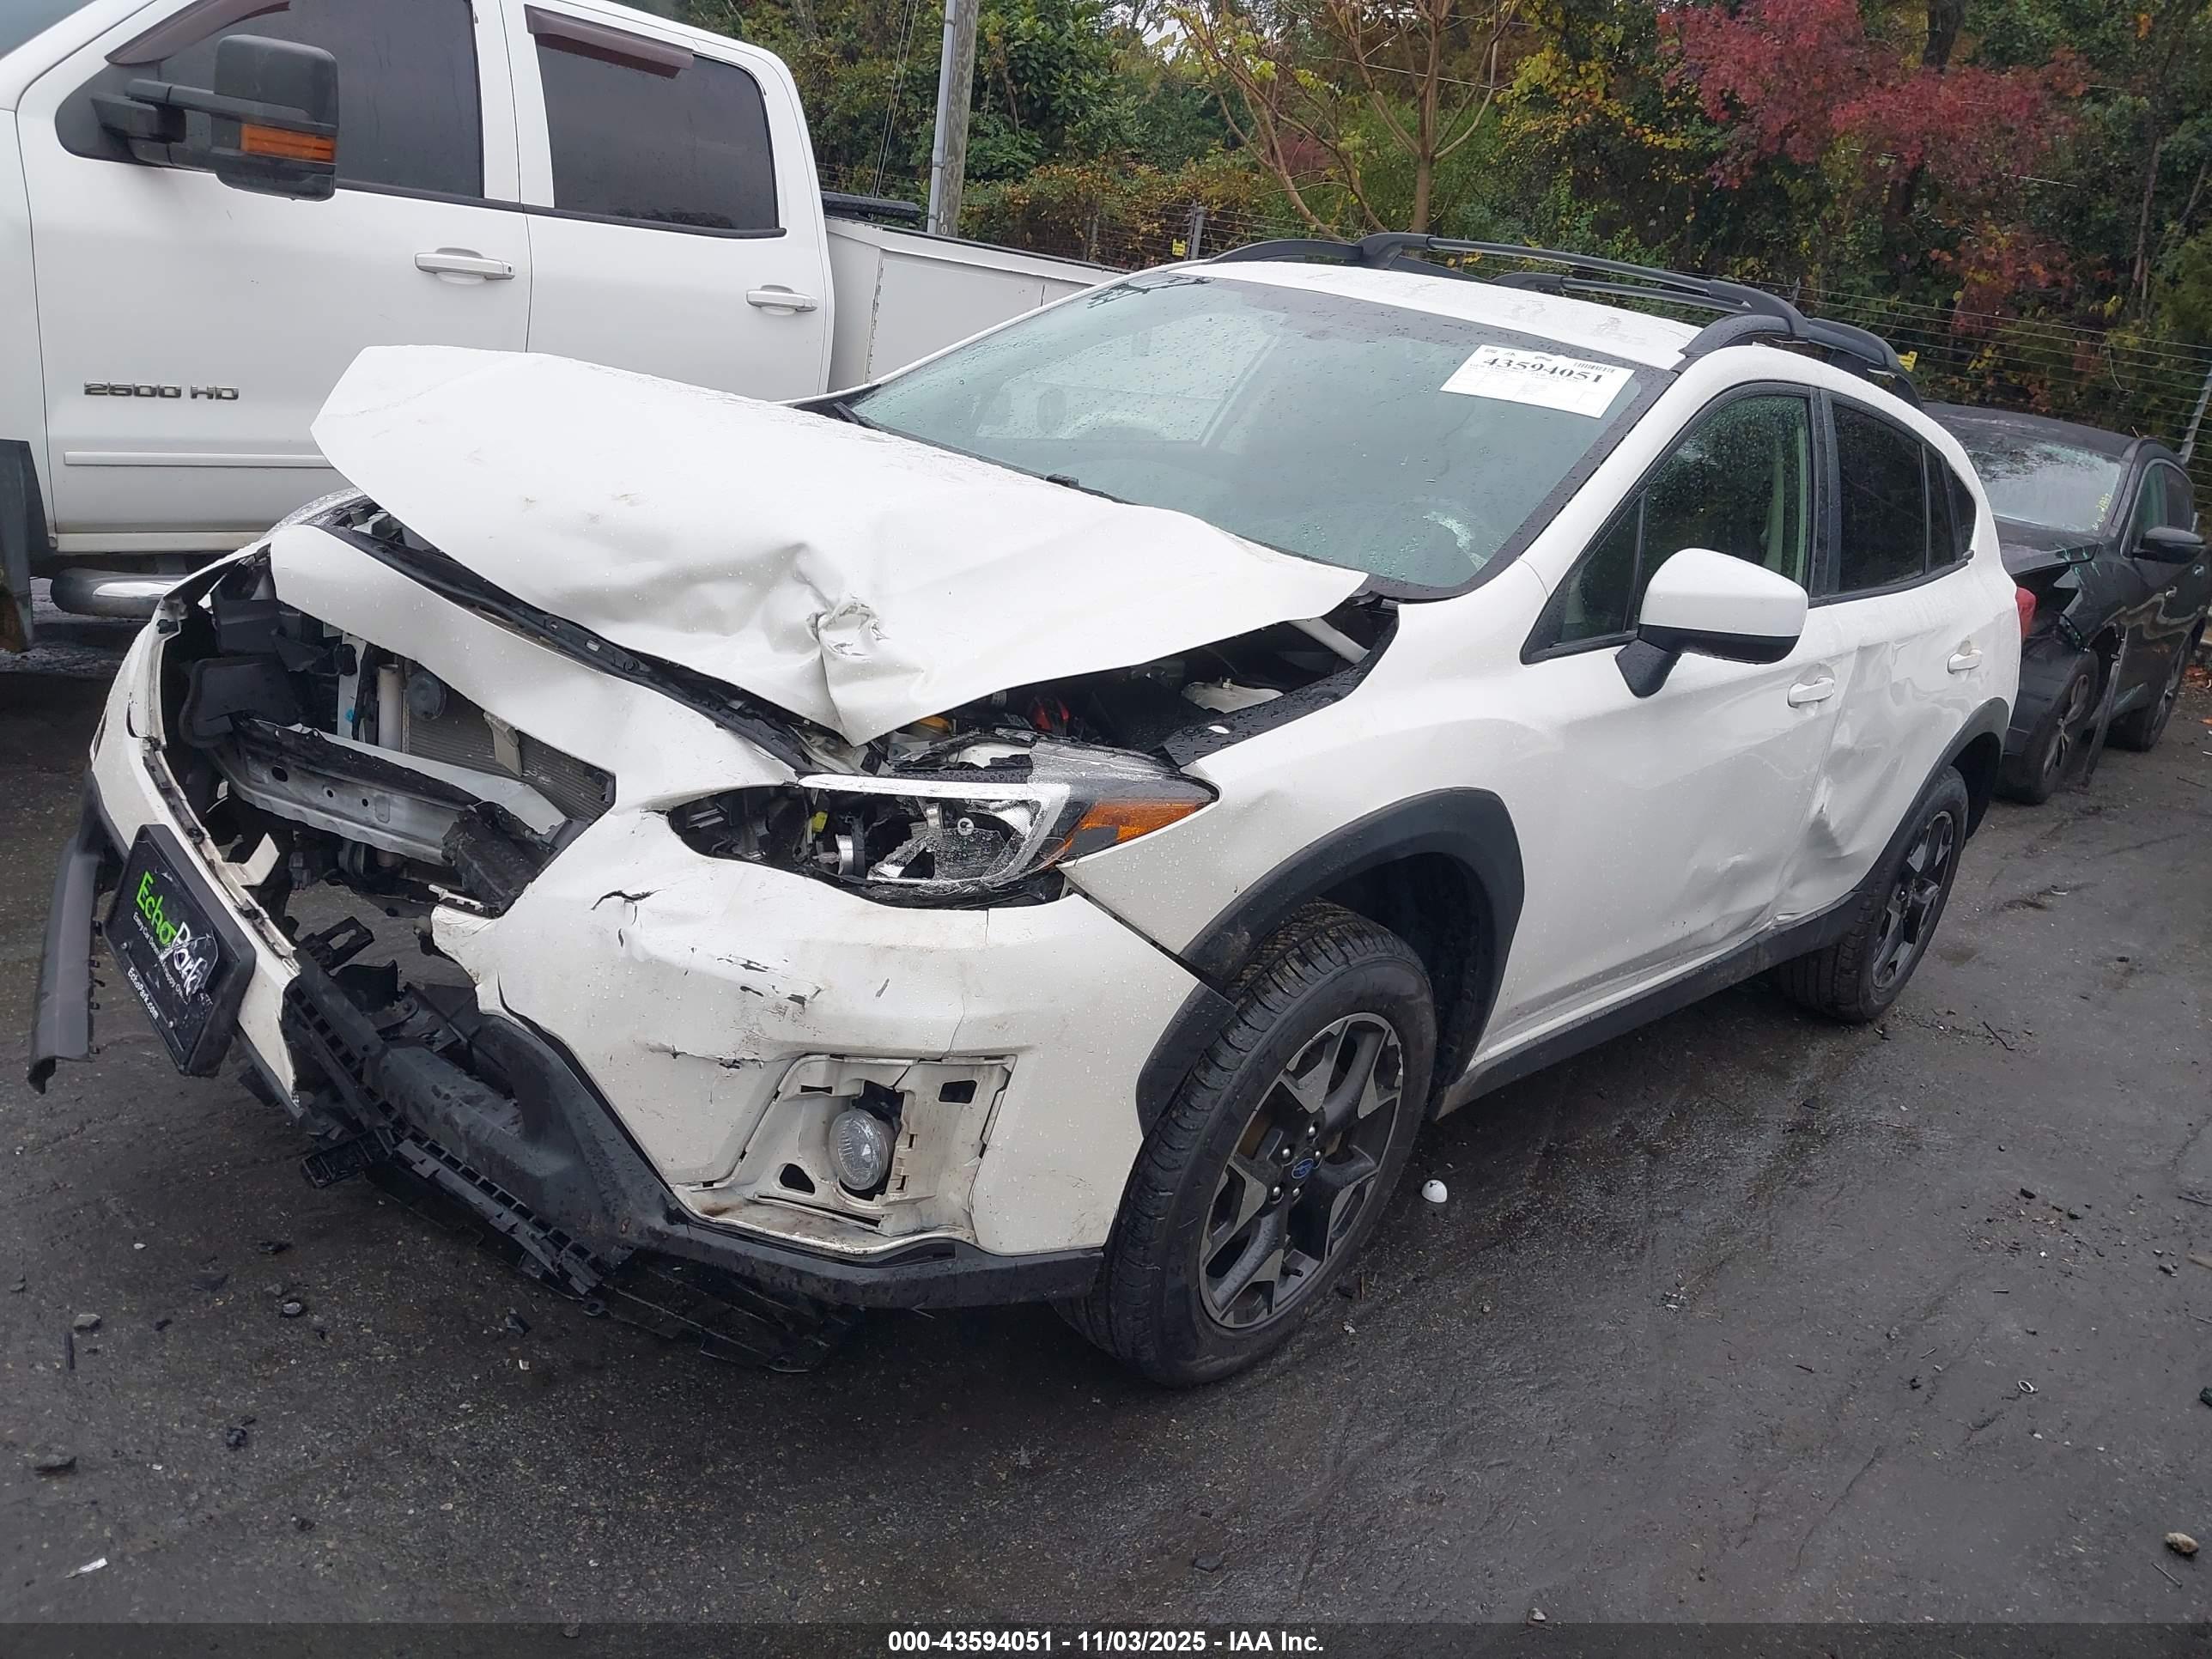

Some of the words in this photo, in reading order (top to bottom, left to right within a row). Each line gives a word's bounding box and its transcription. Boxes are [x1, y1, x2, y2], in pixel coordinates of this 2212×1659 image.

[1483, 358, 1603, 383] 43594051
[84, 380, 182, 398] 2500
[190, 385, 240, 401] HD
[126, 966, 160, 1020] EchoPark.com
